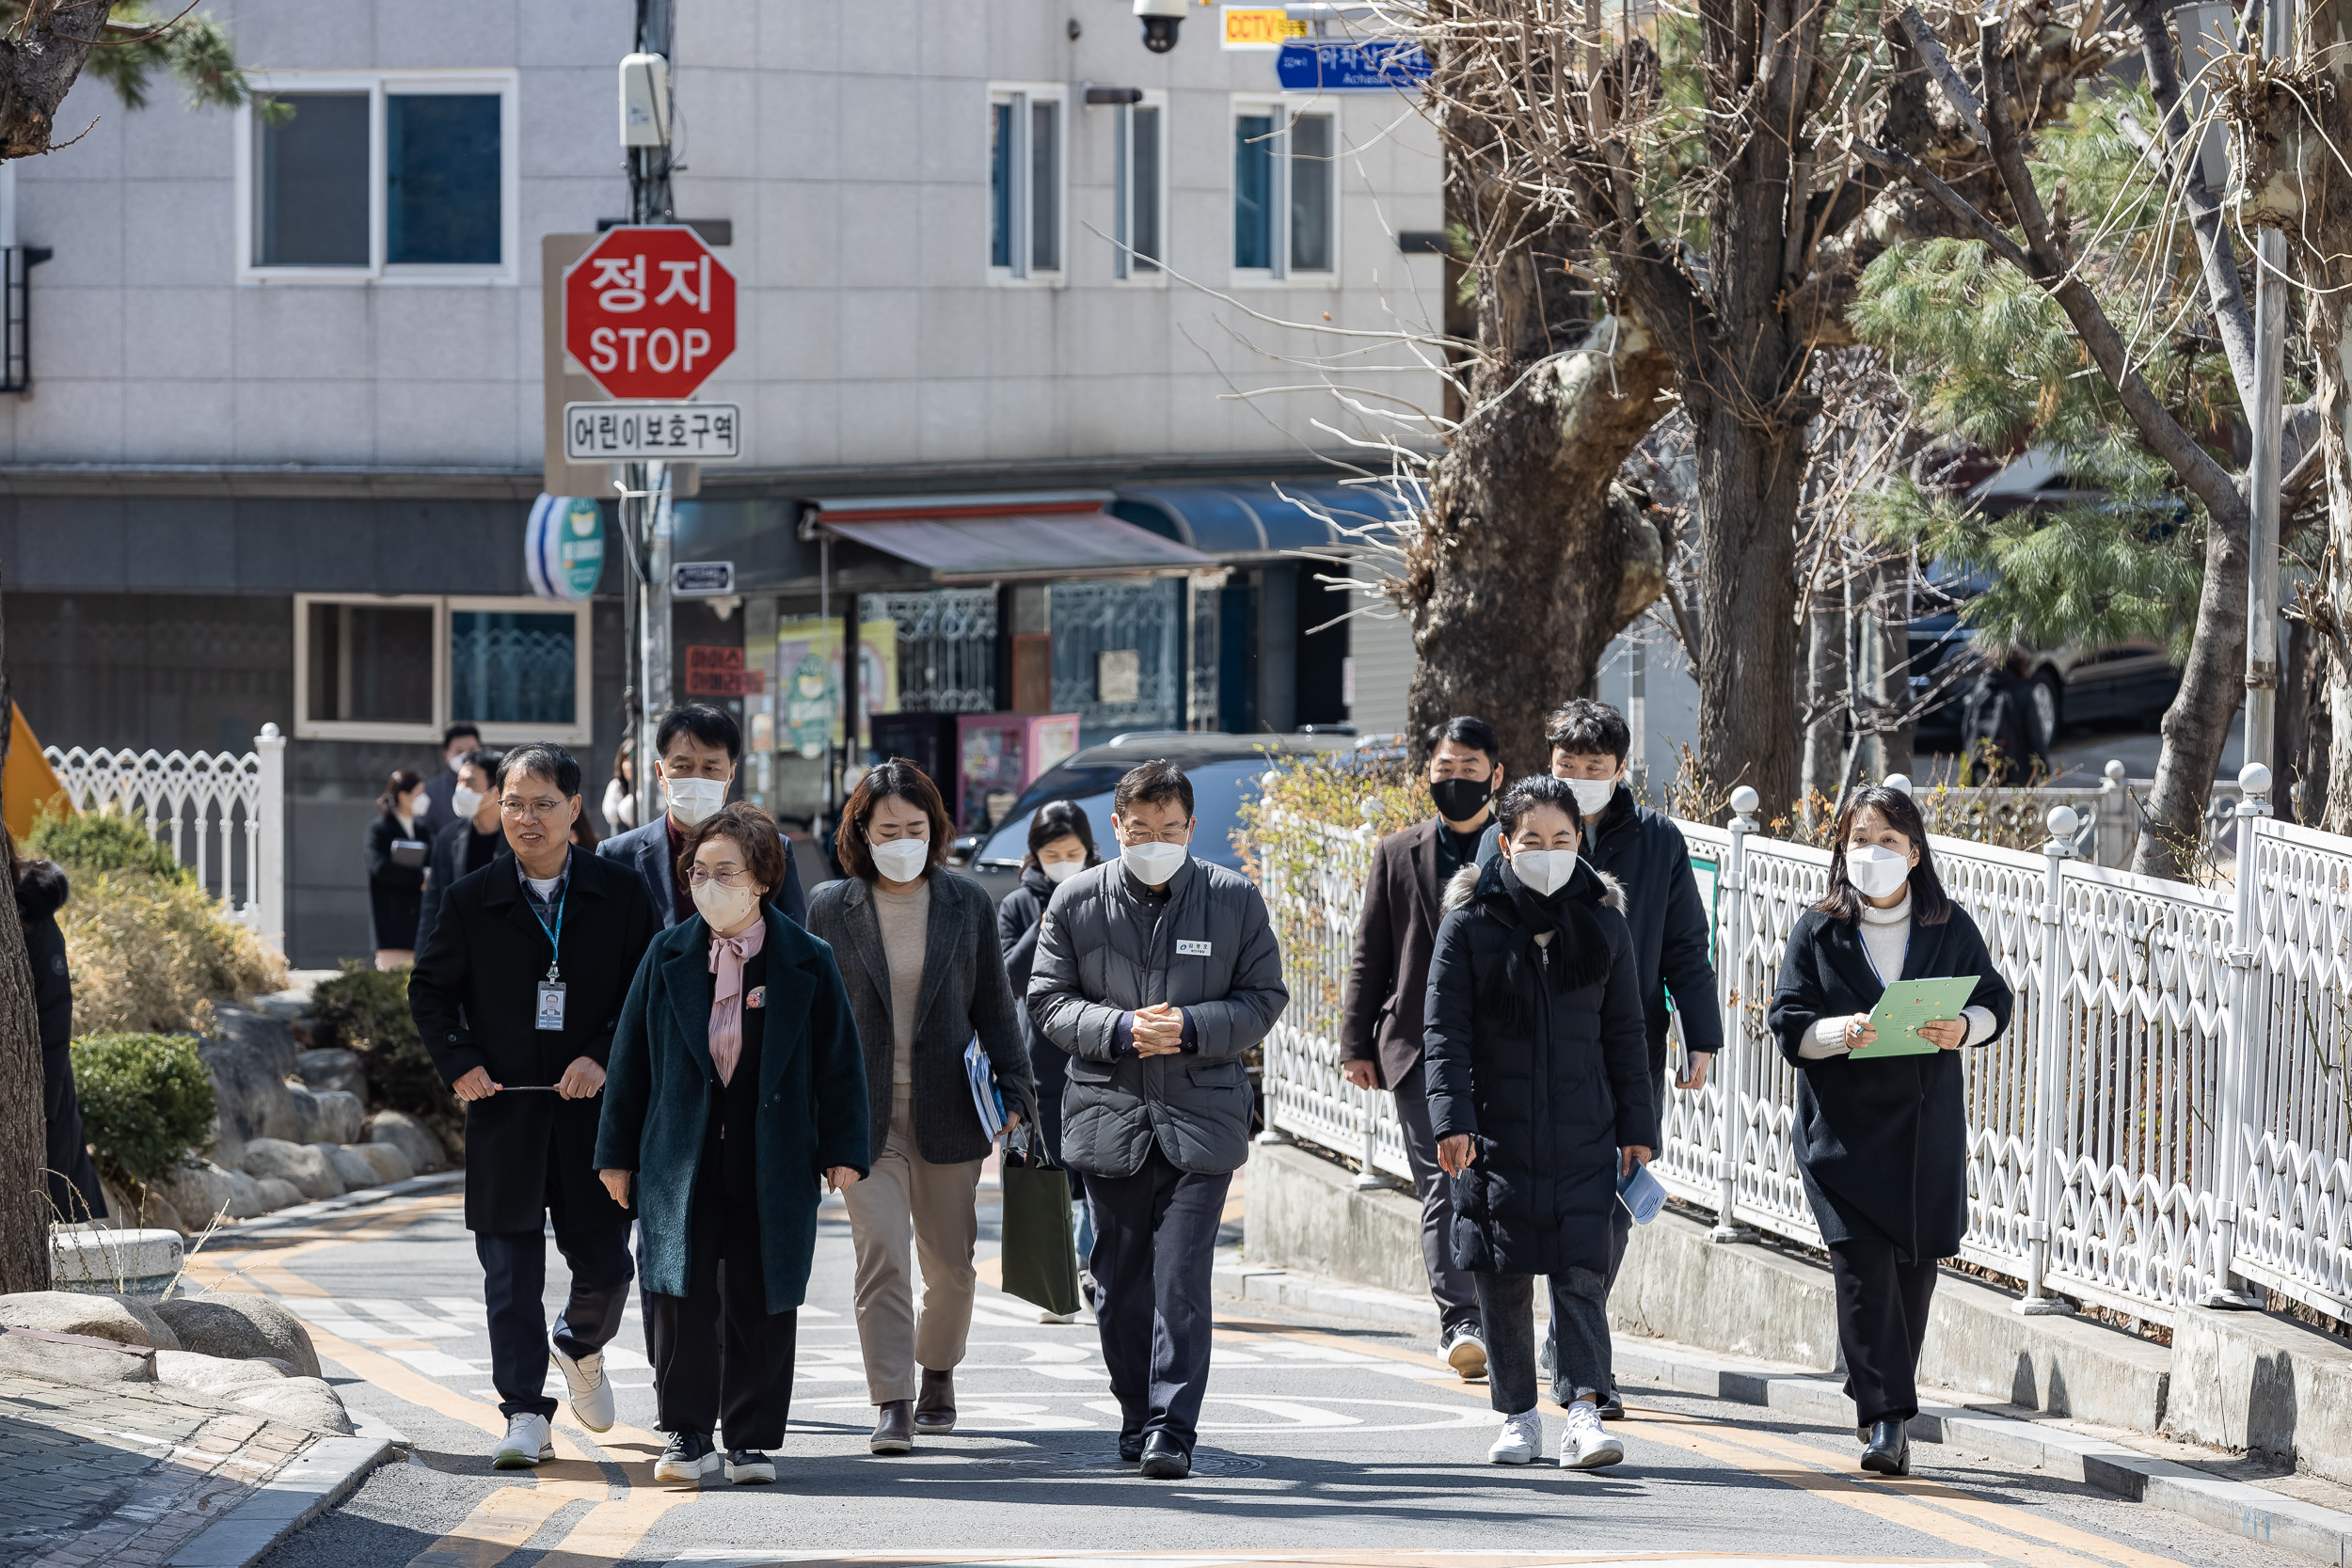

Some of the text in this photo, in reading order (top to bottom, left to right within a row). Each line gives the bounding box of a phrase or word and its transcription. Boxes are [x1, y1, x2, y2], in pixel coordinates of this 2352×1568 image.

[1227, 14, 1276, 39] CCTV
[589, 253, 712, 314] 정지
[588, 326, 712, 373] STOP
[575, 414, 733, 451] 어린이보호구역
